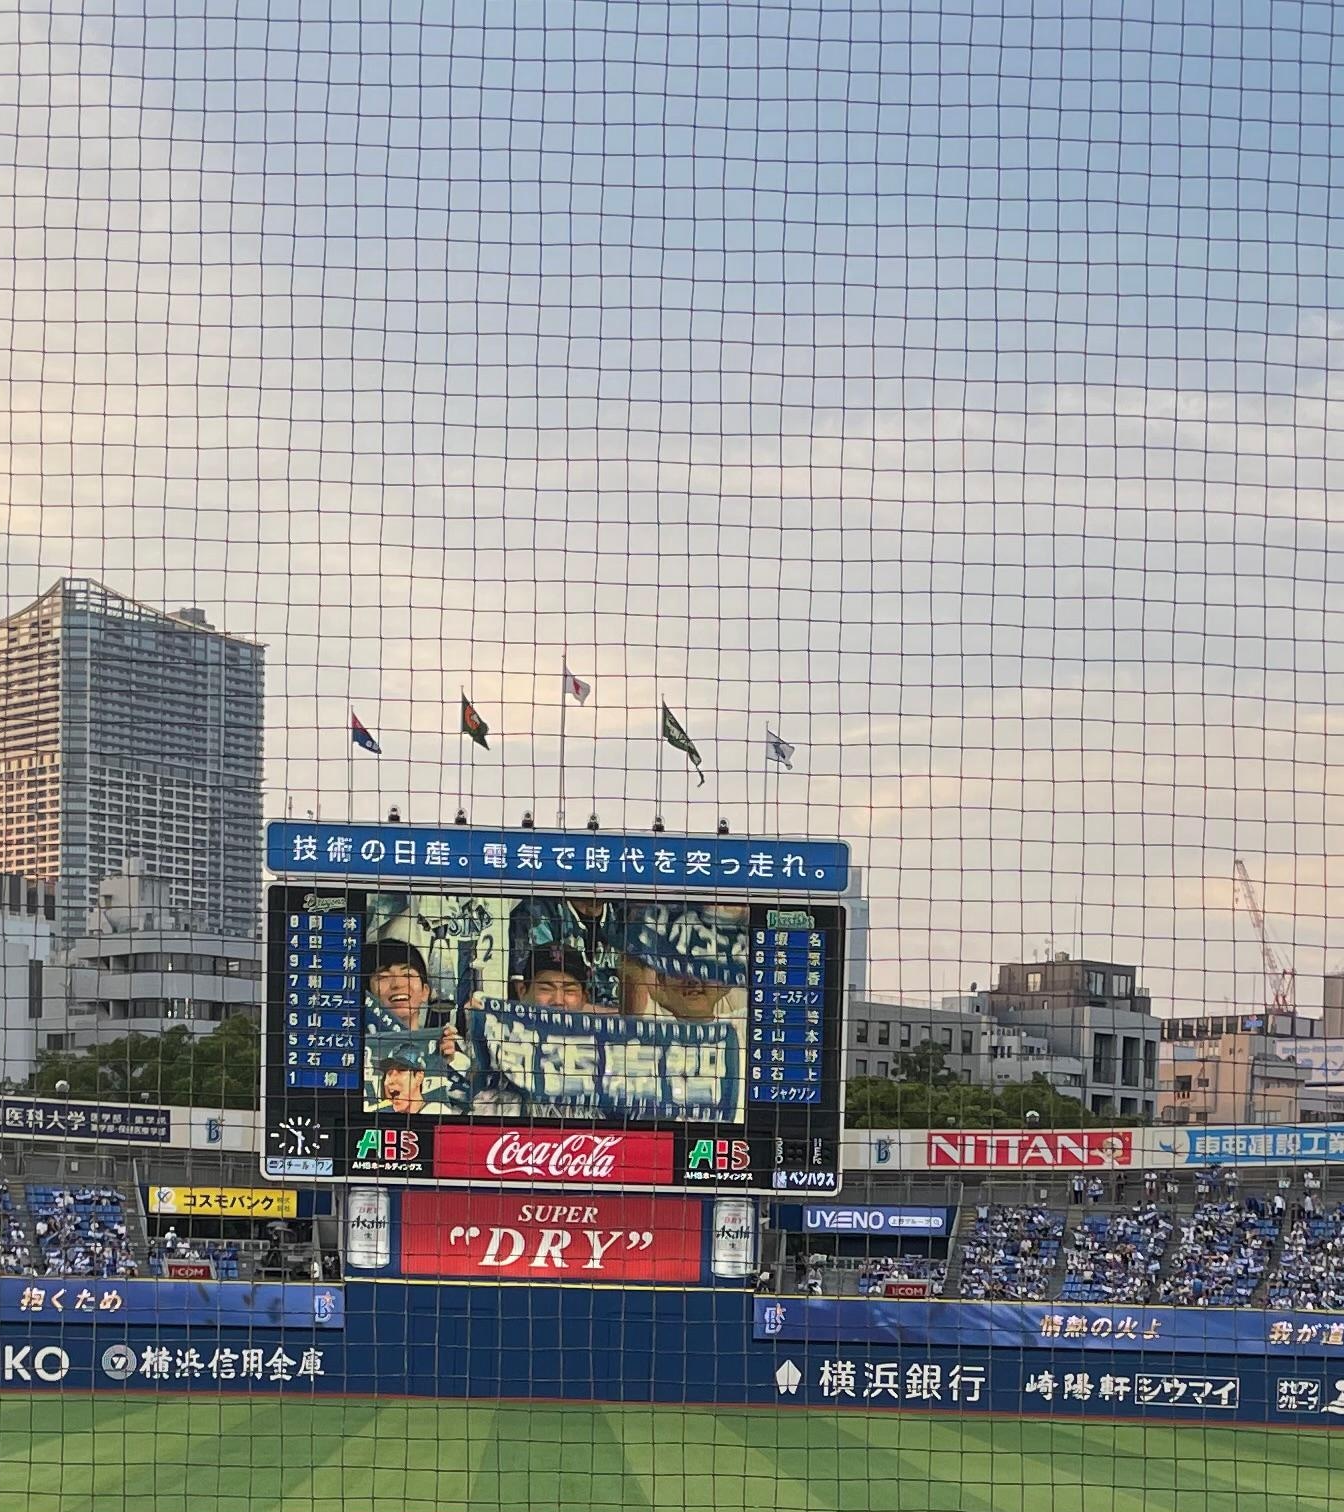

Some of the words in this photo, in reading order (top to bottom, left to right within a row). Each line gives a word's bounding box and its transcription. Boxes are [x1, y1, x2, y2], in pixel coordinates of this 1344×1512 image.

[293, 835, 825, 879] 技術の日産。電気で時代を突っ走れ。
[486, 1131, 624, 1179] Coca-Cola
[931, 1135, 1090, 1165] NITTAN
[183, 1194, 275, 1211] コスモバンク
[517, 1204, 599, 1224] SUPER
[351, 1215, 386, 1229] Asahi
[716, 1225, 750, 1240] Asahi
[806, 1210, 884, 1230] UYENO
[21, 1286, 123, 1313] 抱くため
[1040, 1314, 1163, 1339] 情熱の火よ
[140, 1345, 325, 1383] 横浜信用金庫
[819, 1359, 986, 1402] 横浜銀行
[1025, 1370, 1133, 1402] 崎陽軒
[1138, 1376, 1236, 1405] シウマイ
[1278, 1380, 1319, 1395] オセアン
[1278, 1396, 1319, 1411] グループ
